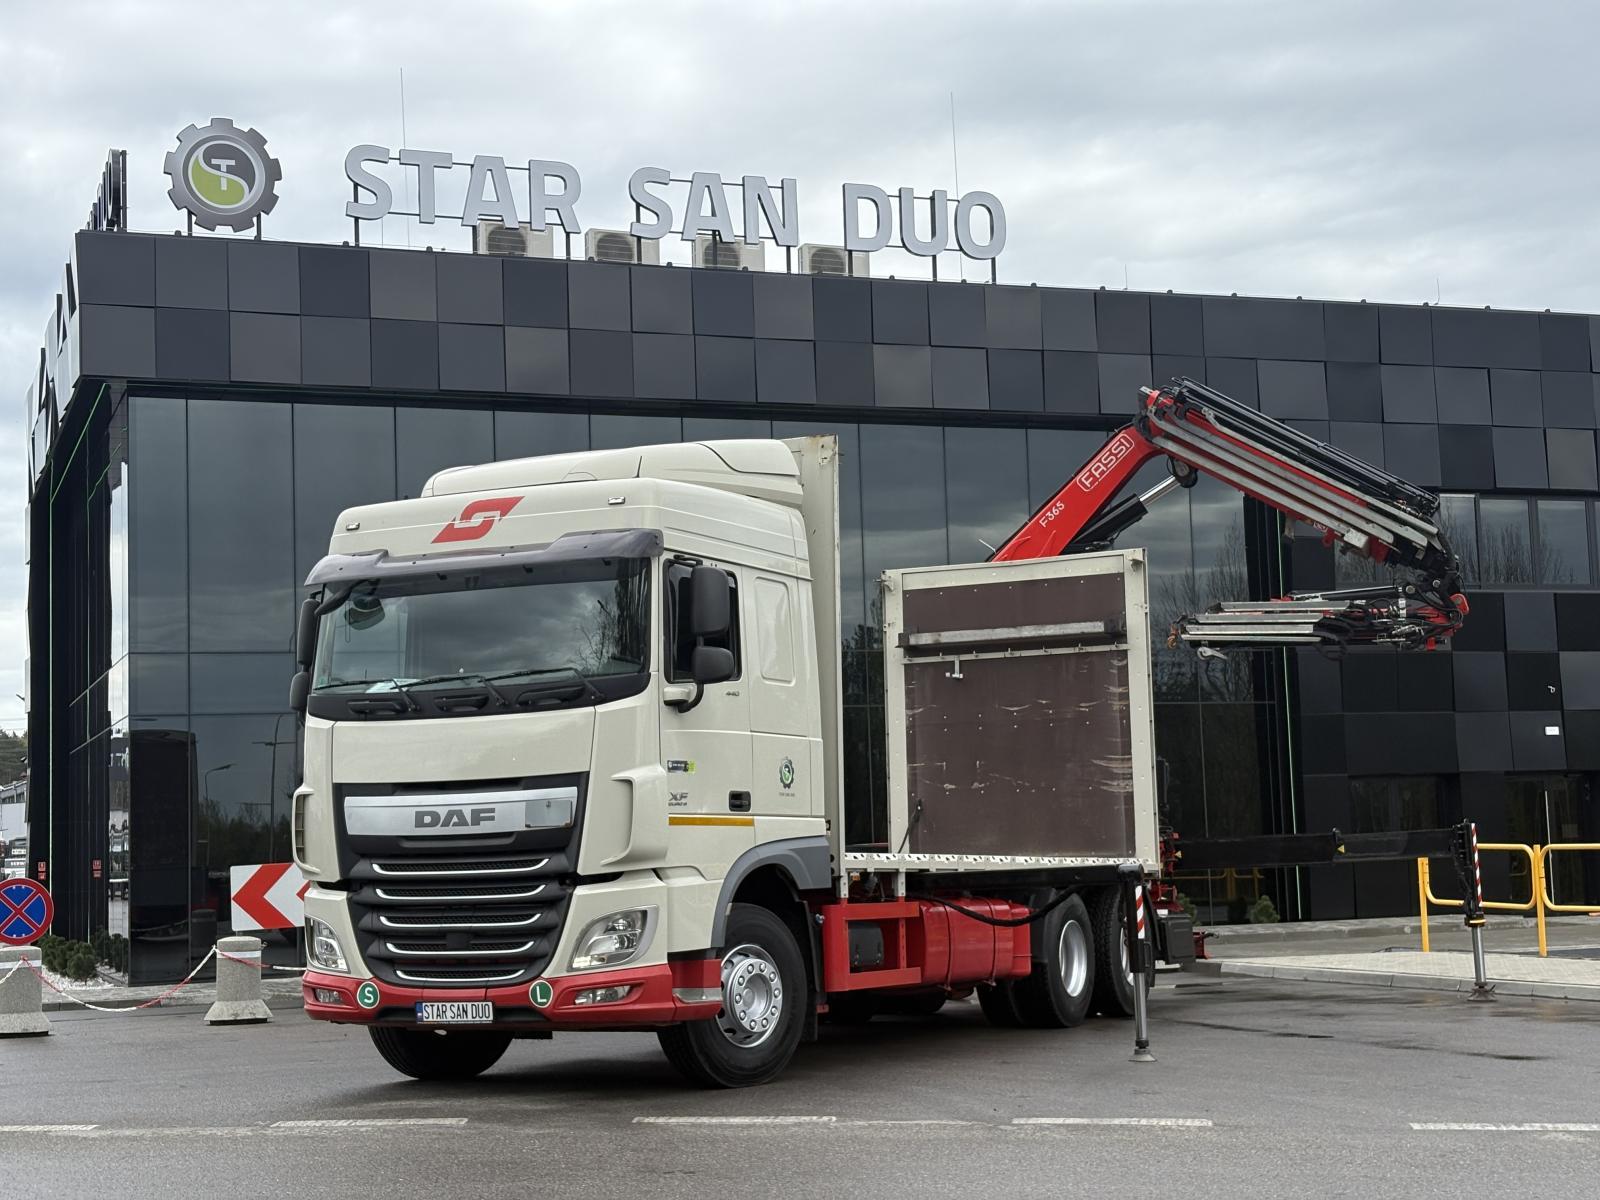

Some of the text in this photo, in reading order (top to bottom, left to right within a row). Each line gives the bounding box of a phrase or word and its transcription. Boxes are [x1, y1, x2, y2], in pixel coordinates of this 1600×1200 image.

[344, 144, 1007, 260] STAR SAN DUO
[1081, 438, 1131, 488] FASSI
[1038, 500, 1066, 528] F365
[414, 807, 496, 829] DAF
[363, 986, 374, 1004] S
[535, 985, 547, 1003] L
[423, 1003, 491, 1020] STAR SAN DUO
